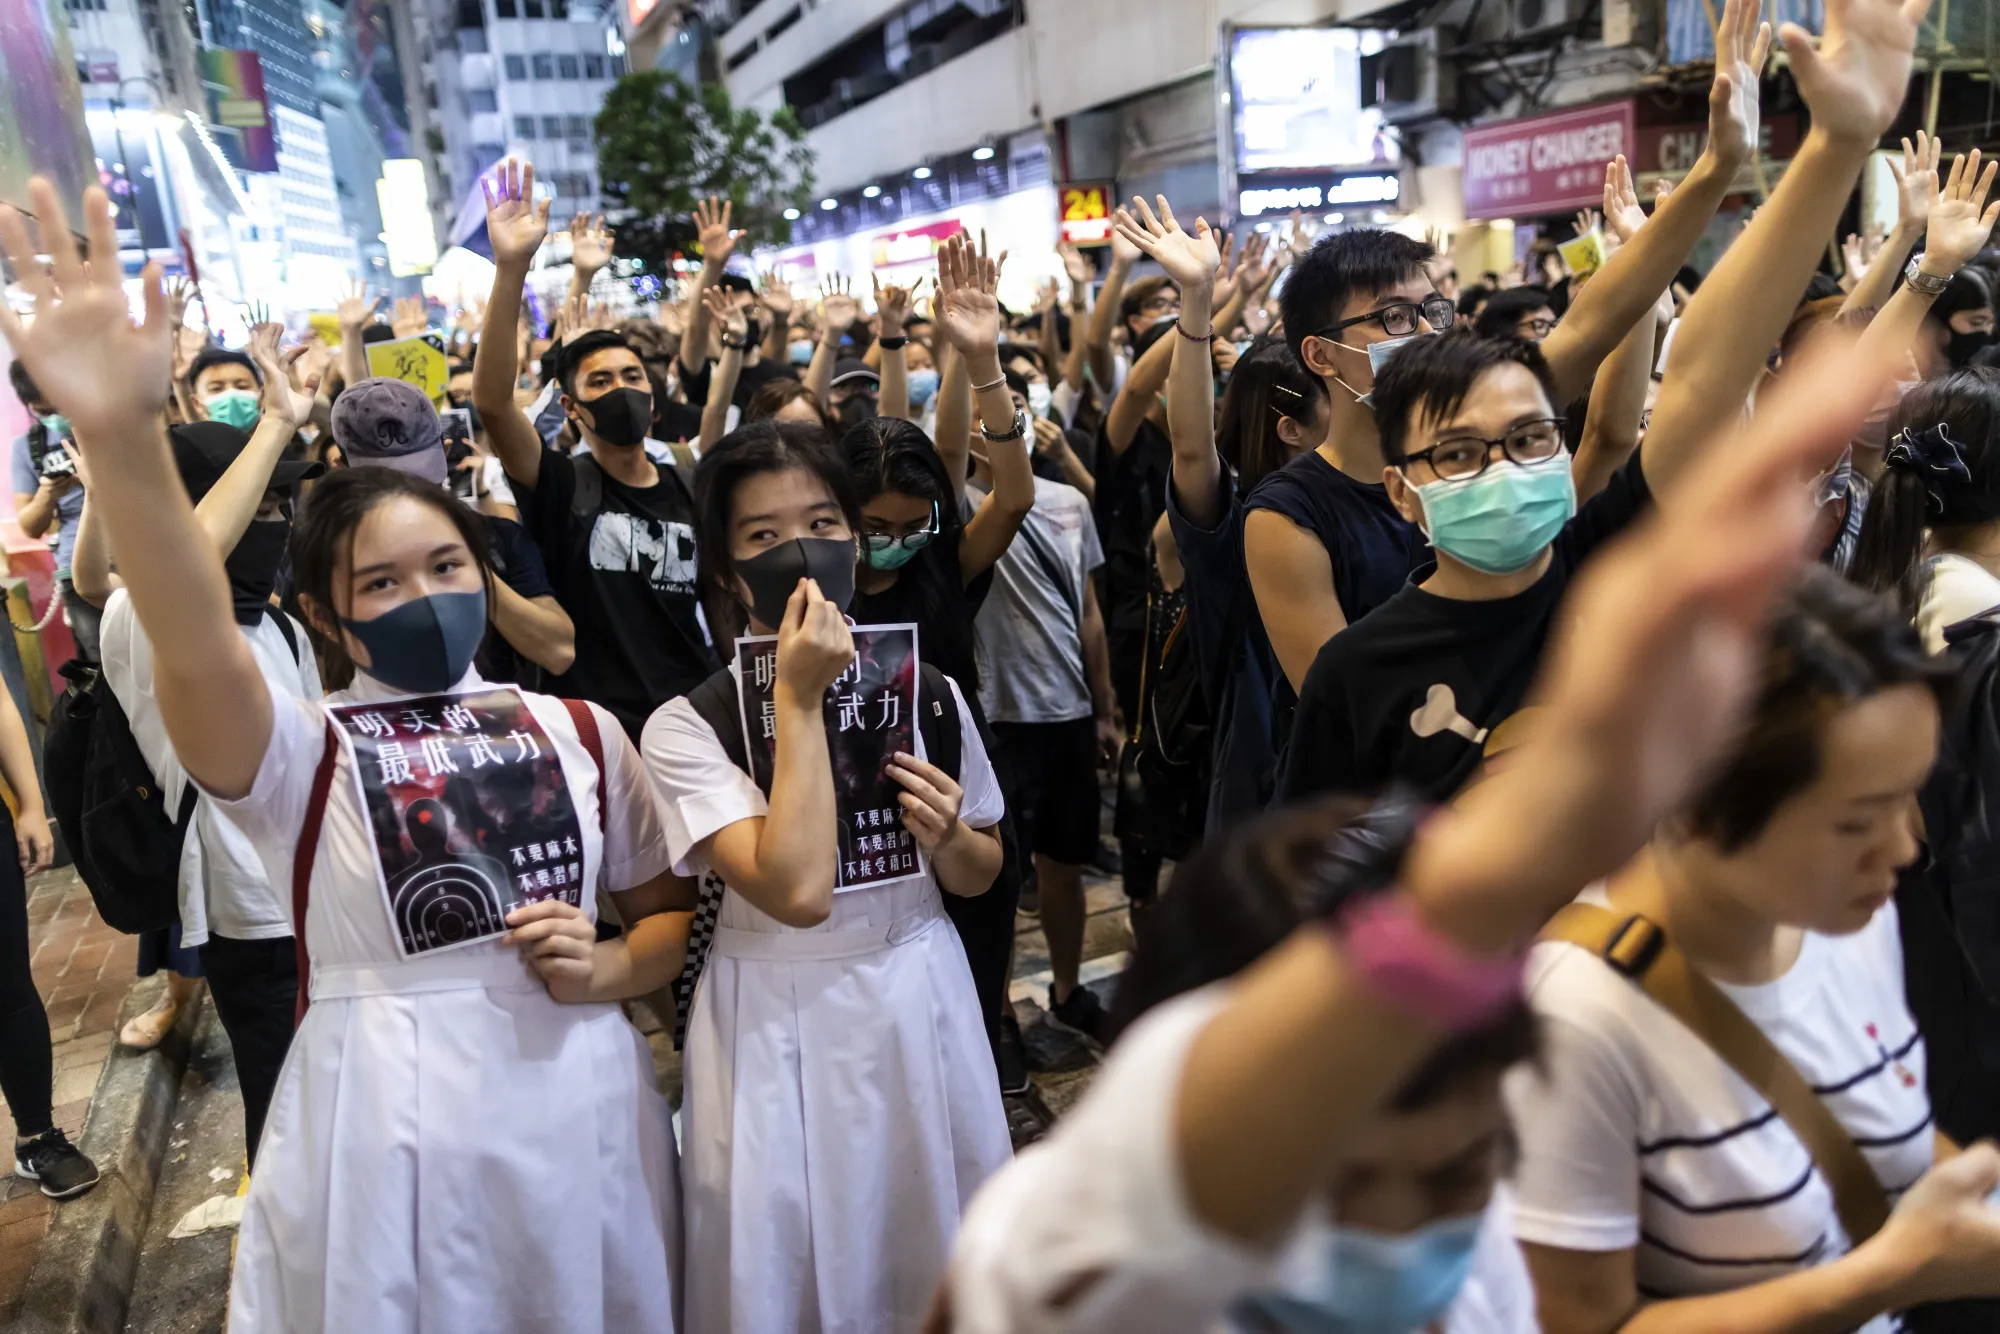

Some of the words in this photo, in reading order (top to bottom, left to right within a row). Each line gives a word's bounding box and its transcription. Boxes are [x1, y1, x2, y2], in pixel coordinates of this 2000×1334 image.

[1468, 139, 1531, 179] MONEY
[1531, 121, 1624, 173] CHANGER
[1064, 188, 1105, 221] 24
[351, 703, 480, 738] 明天的
[760, 690, 899, 739] 最武力
[376, 729, 541, 785] 最低武力
[509, 836, 578, 866] 不要麻木
[857, 829, 910, 854] 不要習慣
